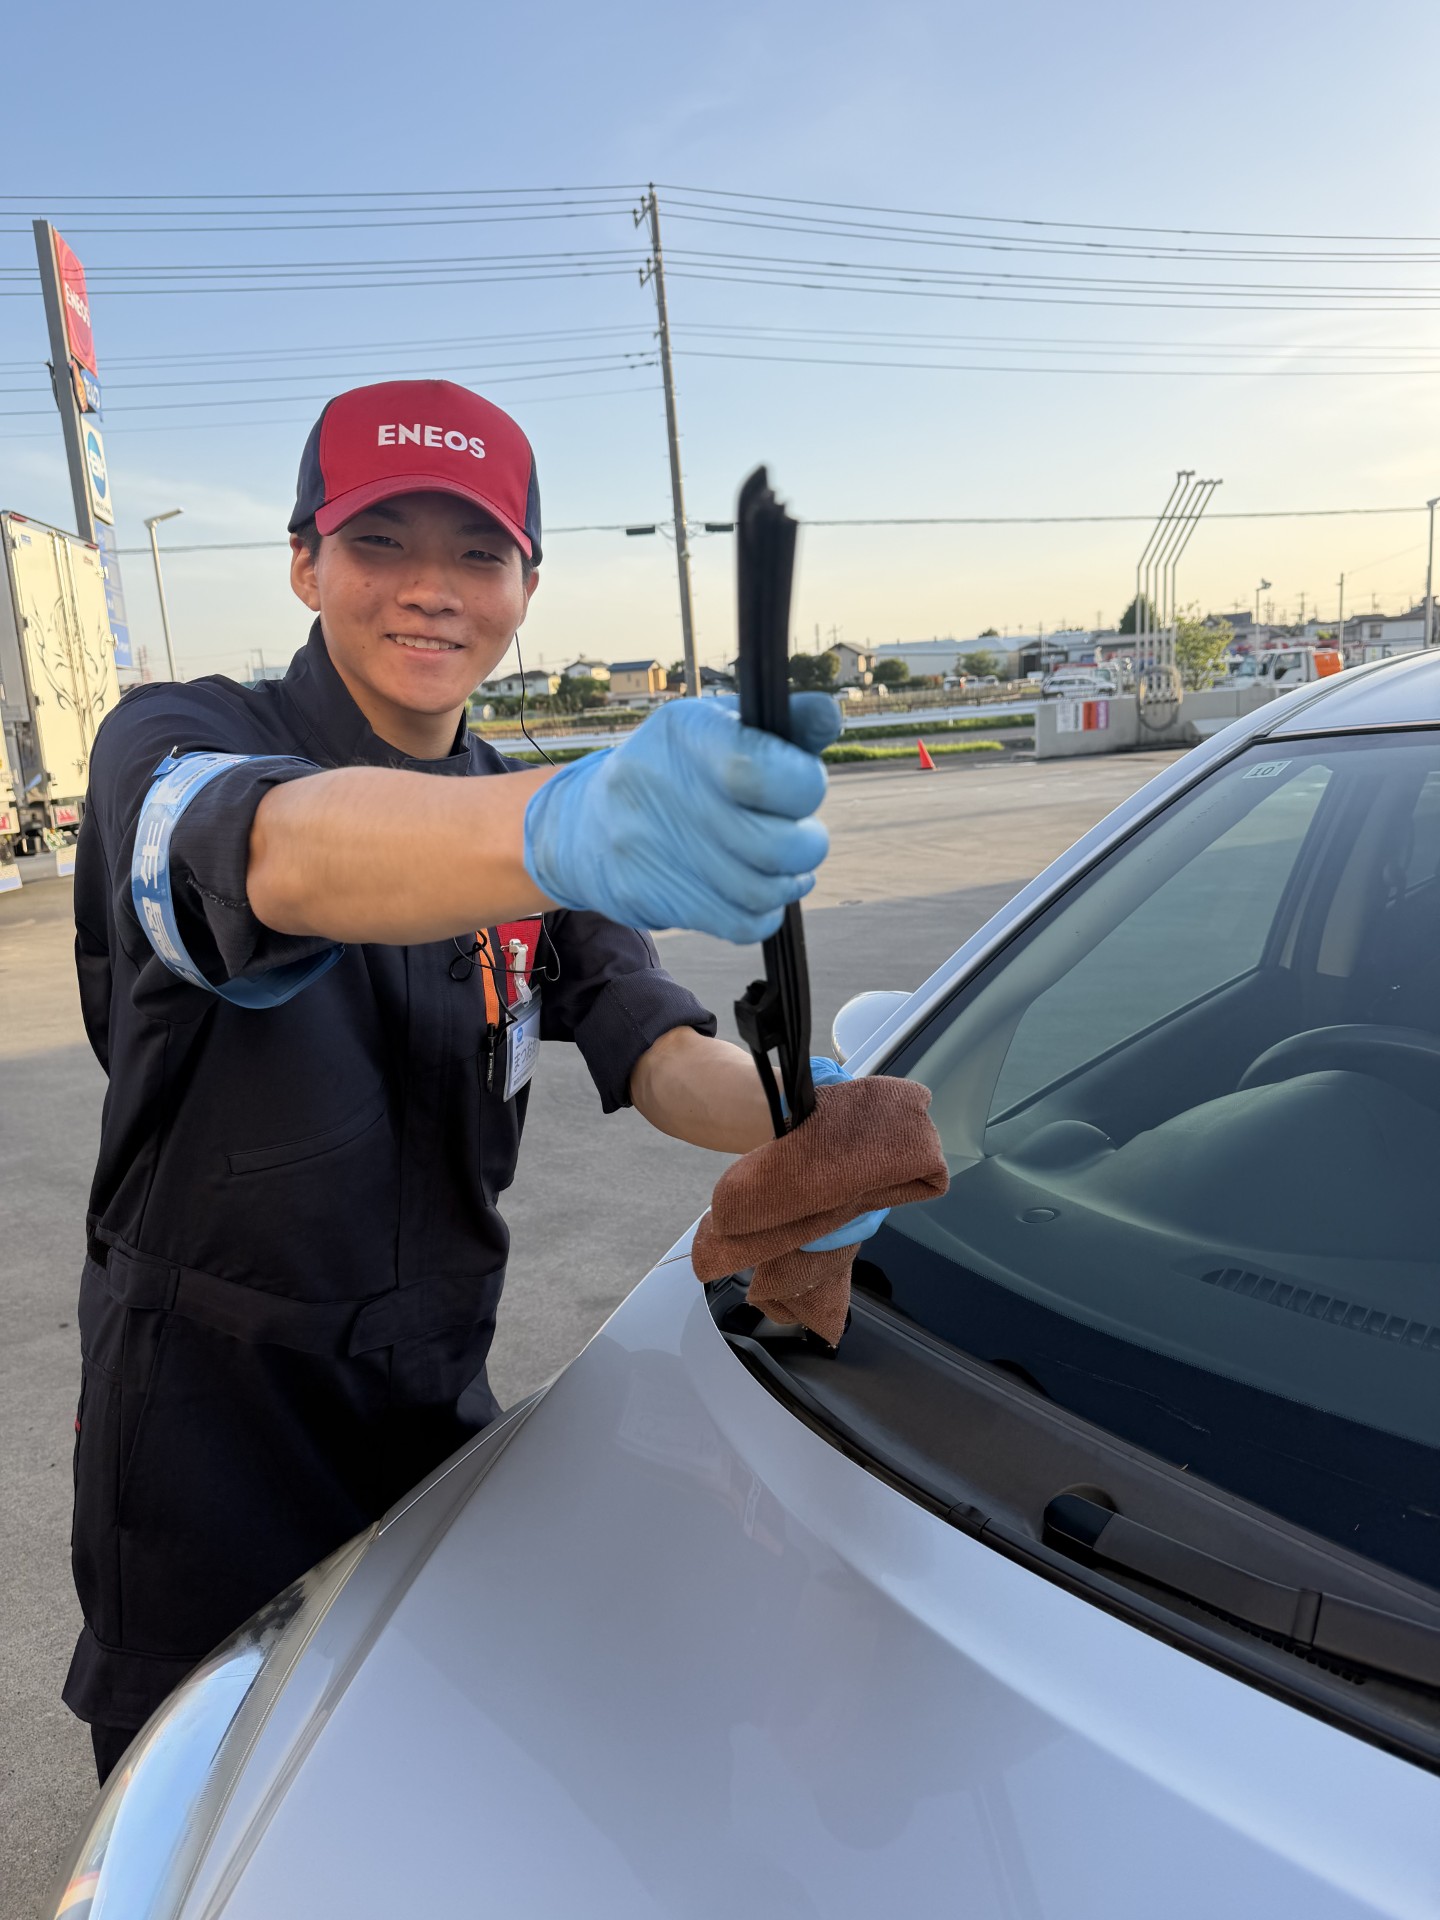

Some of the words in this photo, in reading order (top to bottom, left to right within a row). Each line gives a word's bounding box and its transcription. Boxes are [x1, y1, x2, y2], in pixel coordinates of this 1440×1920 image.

[64, 281, 91, 329] ENEOS
[378, 423, 486, 459] ENEOS
[1250, 766, 1276, 776] 10
